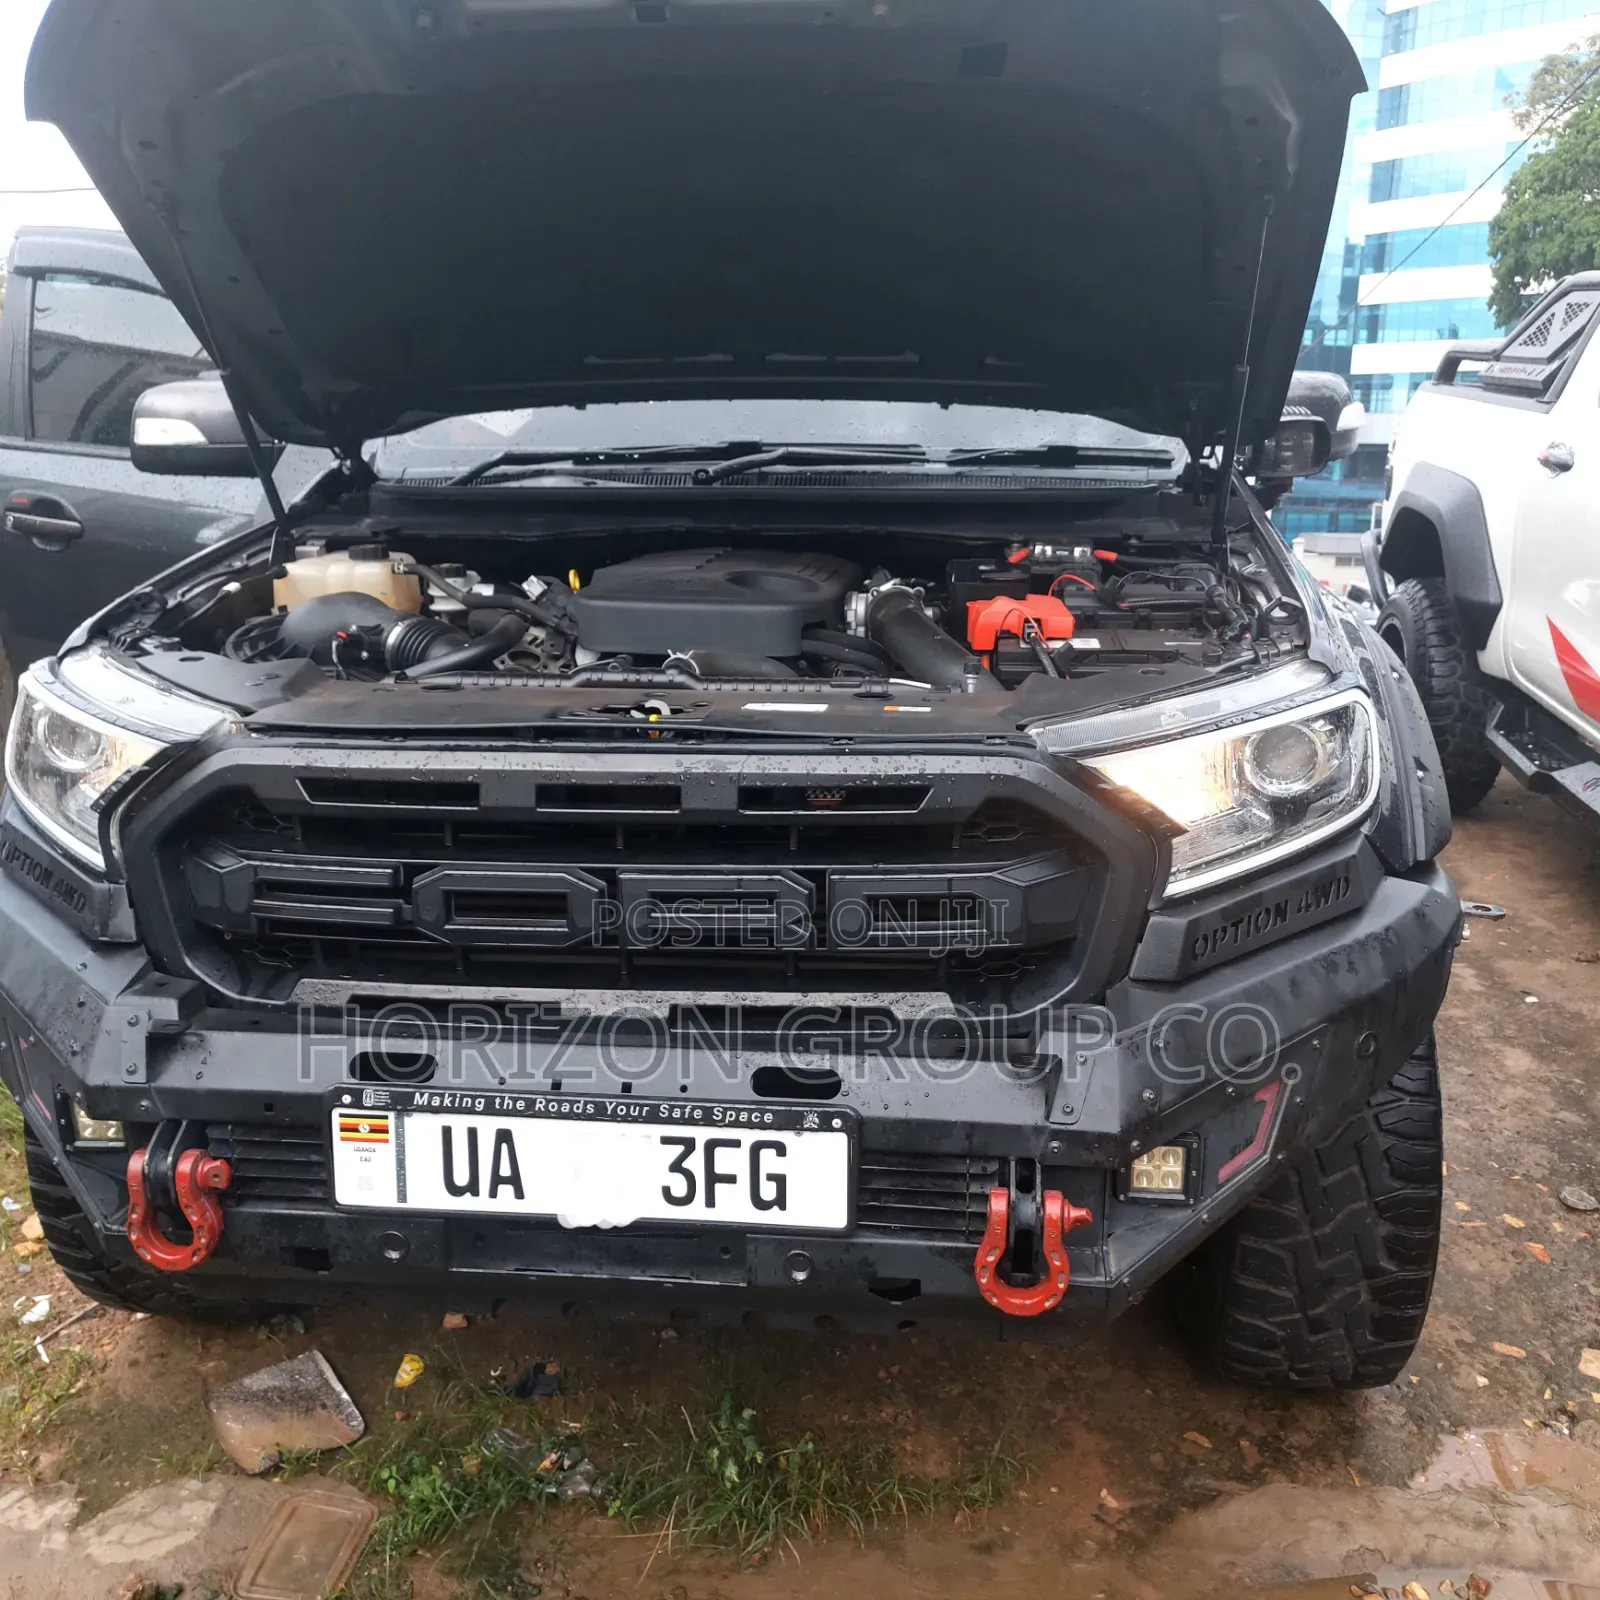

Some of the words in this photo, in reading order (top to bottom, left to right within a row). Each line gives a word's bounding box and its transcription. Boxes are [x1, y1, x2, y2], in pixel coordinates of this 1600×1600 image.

[1, 841, 53, 889] OPTION
[1191, 899, 1290, 962] OPTION
[1297, 875, 1351, 915] 4WD
[412, 1091, 486, 1111] Making
[494, 1096, 526, 1111] the
[534, 1098, 596, 1114] Roads
[605, 1101, 650, 1117] Your
[658, 1104, 703, 1120] Safe
[711, 1106, 774, 1124] Space
[441, 1124, 525, 1200] UA
[659, 1134, 788, 1212] 3FG
